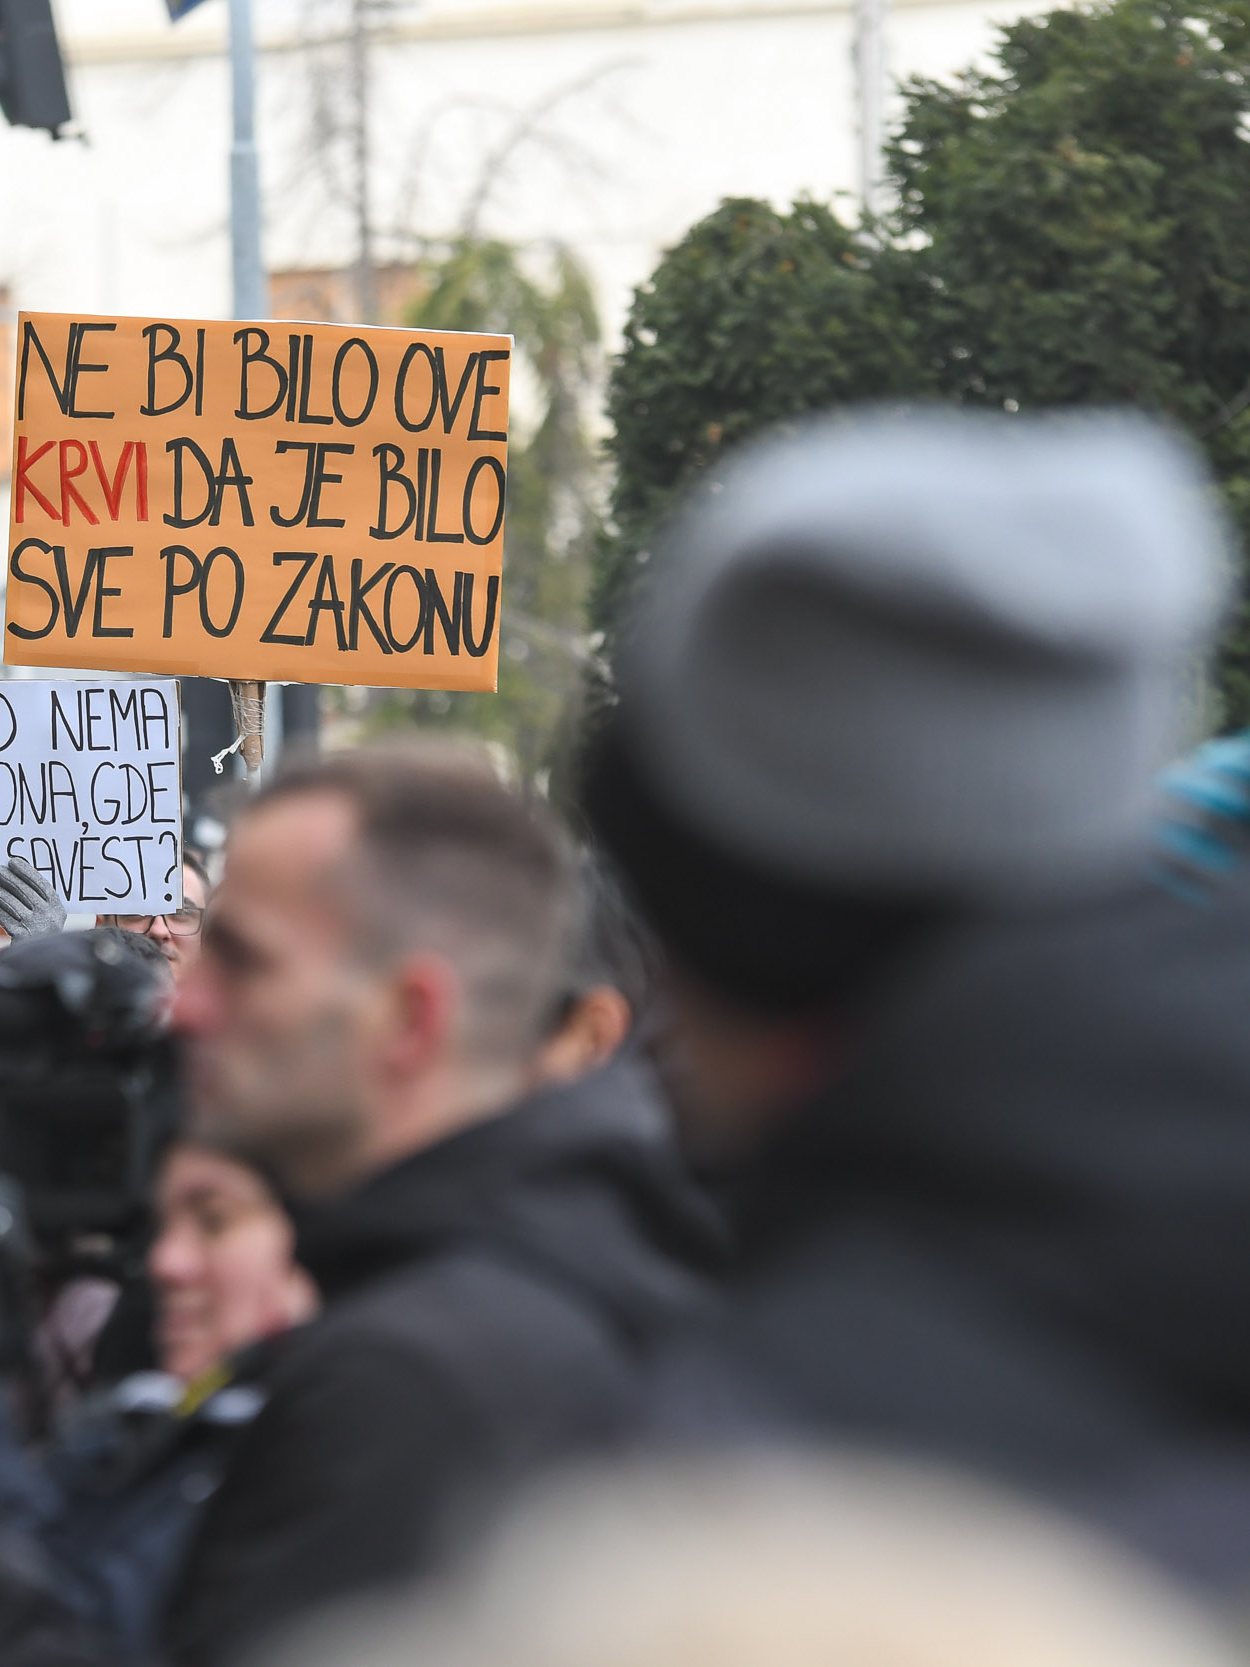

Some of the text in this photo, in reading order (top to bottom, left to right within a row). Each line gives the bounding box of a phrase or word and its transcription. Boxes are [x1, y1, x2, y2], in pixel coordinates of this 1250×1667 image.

[18, 320, 510, 441] NE BI BILO OVE
[15, 436, 506, 546] KRVI DA JE BILO
[7, 538, 500, 657] SVE PO ZAKONU
[51, 688, 170, 751] NEMA
